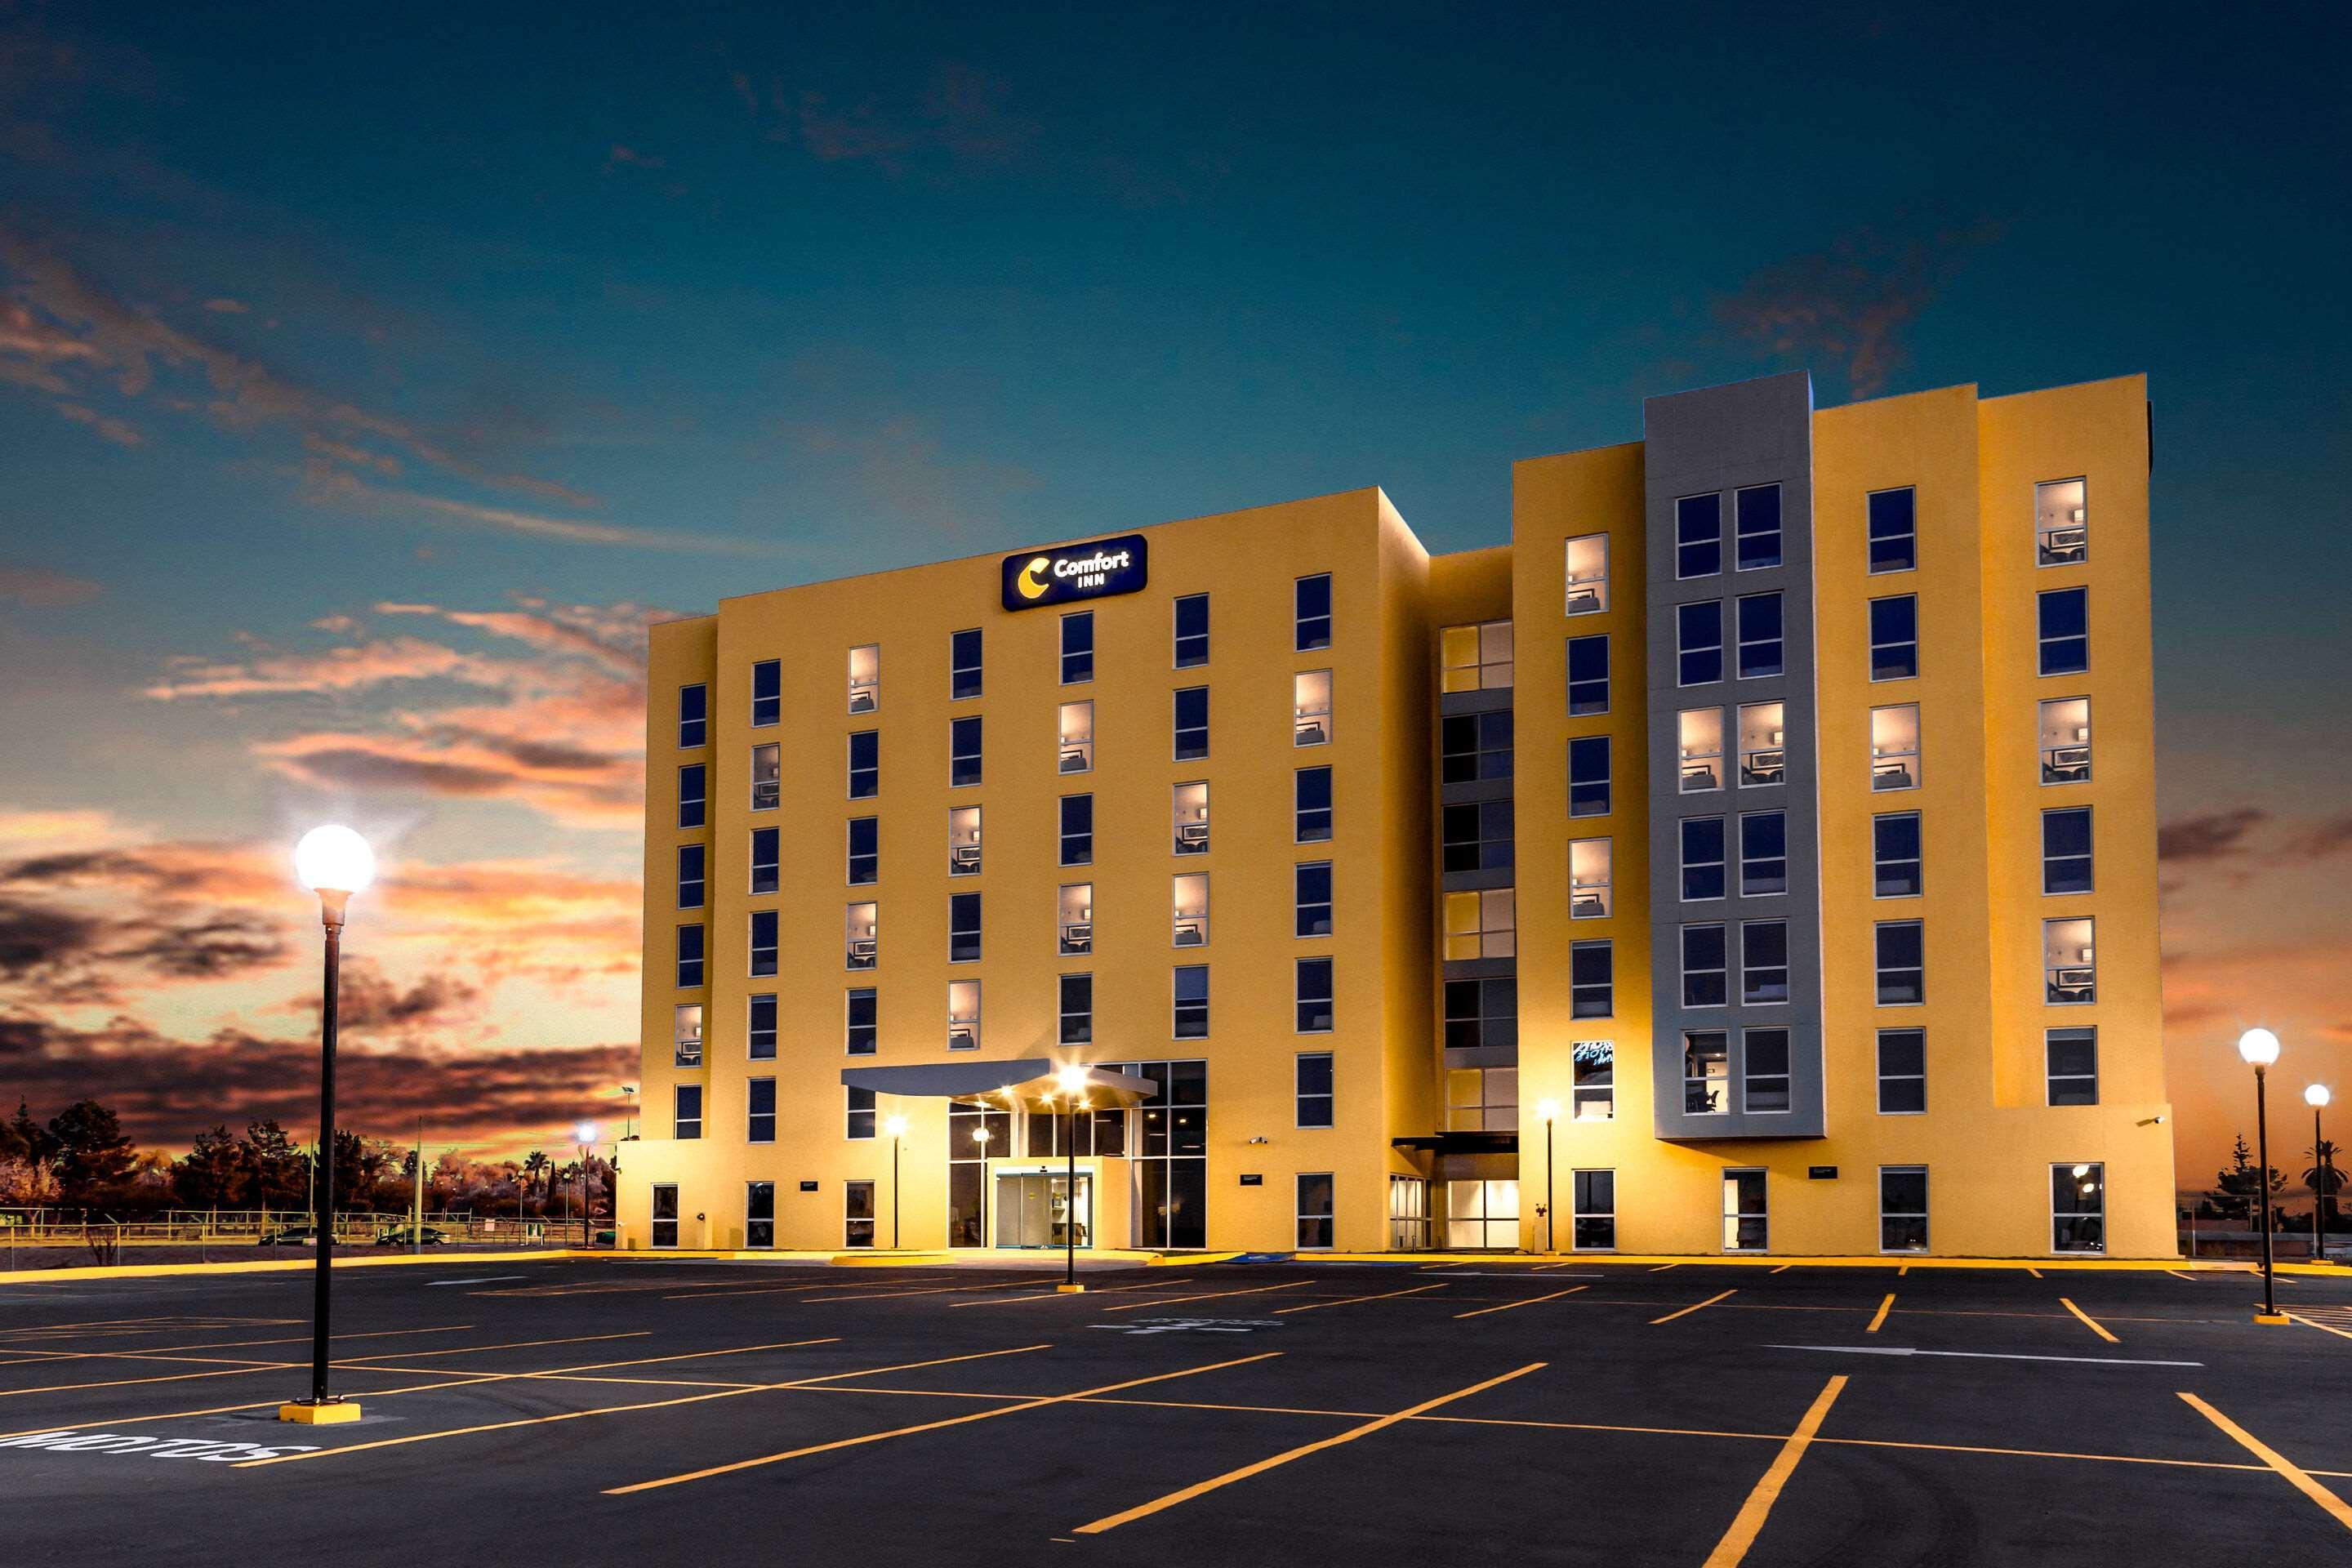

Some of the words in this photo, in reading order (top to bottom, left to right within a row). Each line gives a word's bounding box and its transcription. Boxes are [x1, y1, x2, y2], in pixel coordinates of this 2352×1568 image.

[1054, 550, 1129, 577] Comfort
[1077, 572, 1105, 588] INN
[0, 1431, 322, 1461] MOTOS
